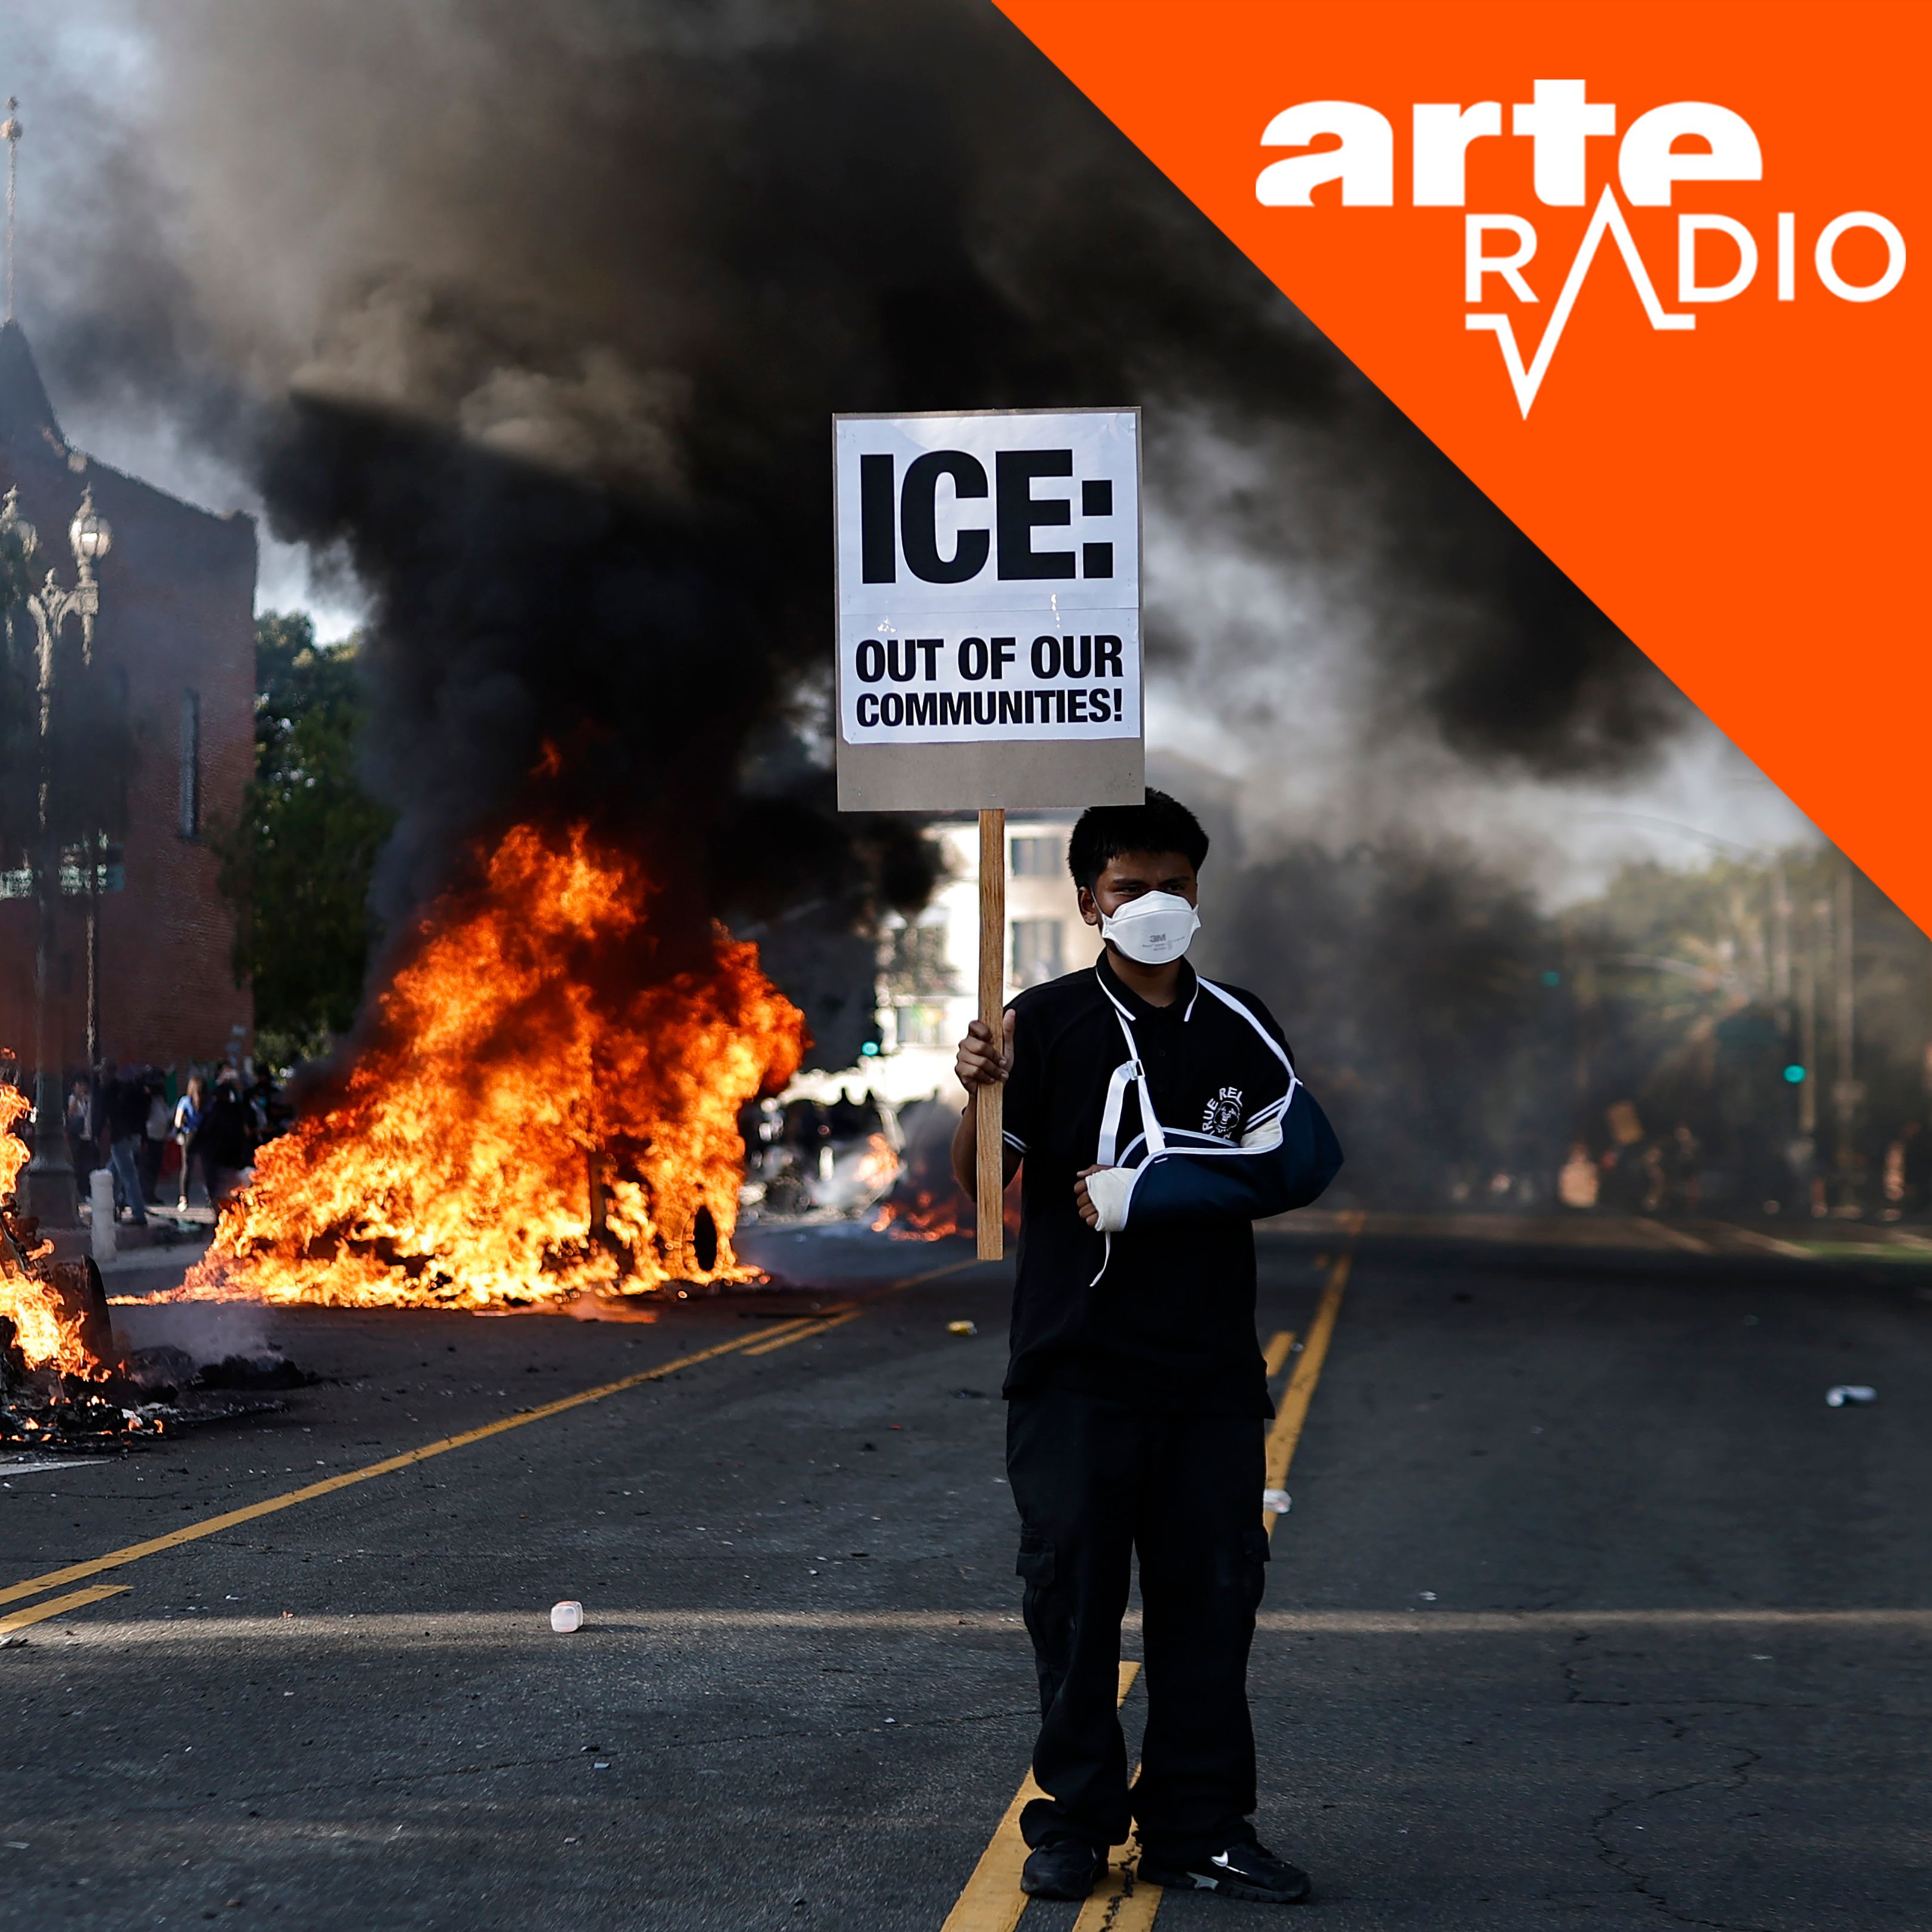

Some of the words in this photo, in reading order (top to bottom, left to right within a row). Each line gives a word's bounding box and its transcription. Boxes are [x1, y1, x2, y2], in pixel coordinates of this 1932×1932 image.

[860, 449, 1113, 584] ICE:
[855, 638, 944, 682] OUT
[957, 637, 1016, 680] OF
[1030, 634, 1124, 679] OUR
[856, 687, 1123, 727] COMMUNITIES!
[1150, 934, 1166, 942] 3M
